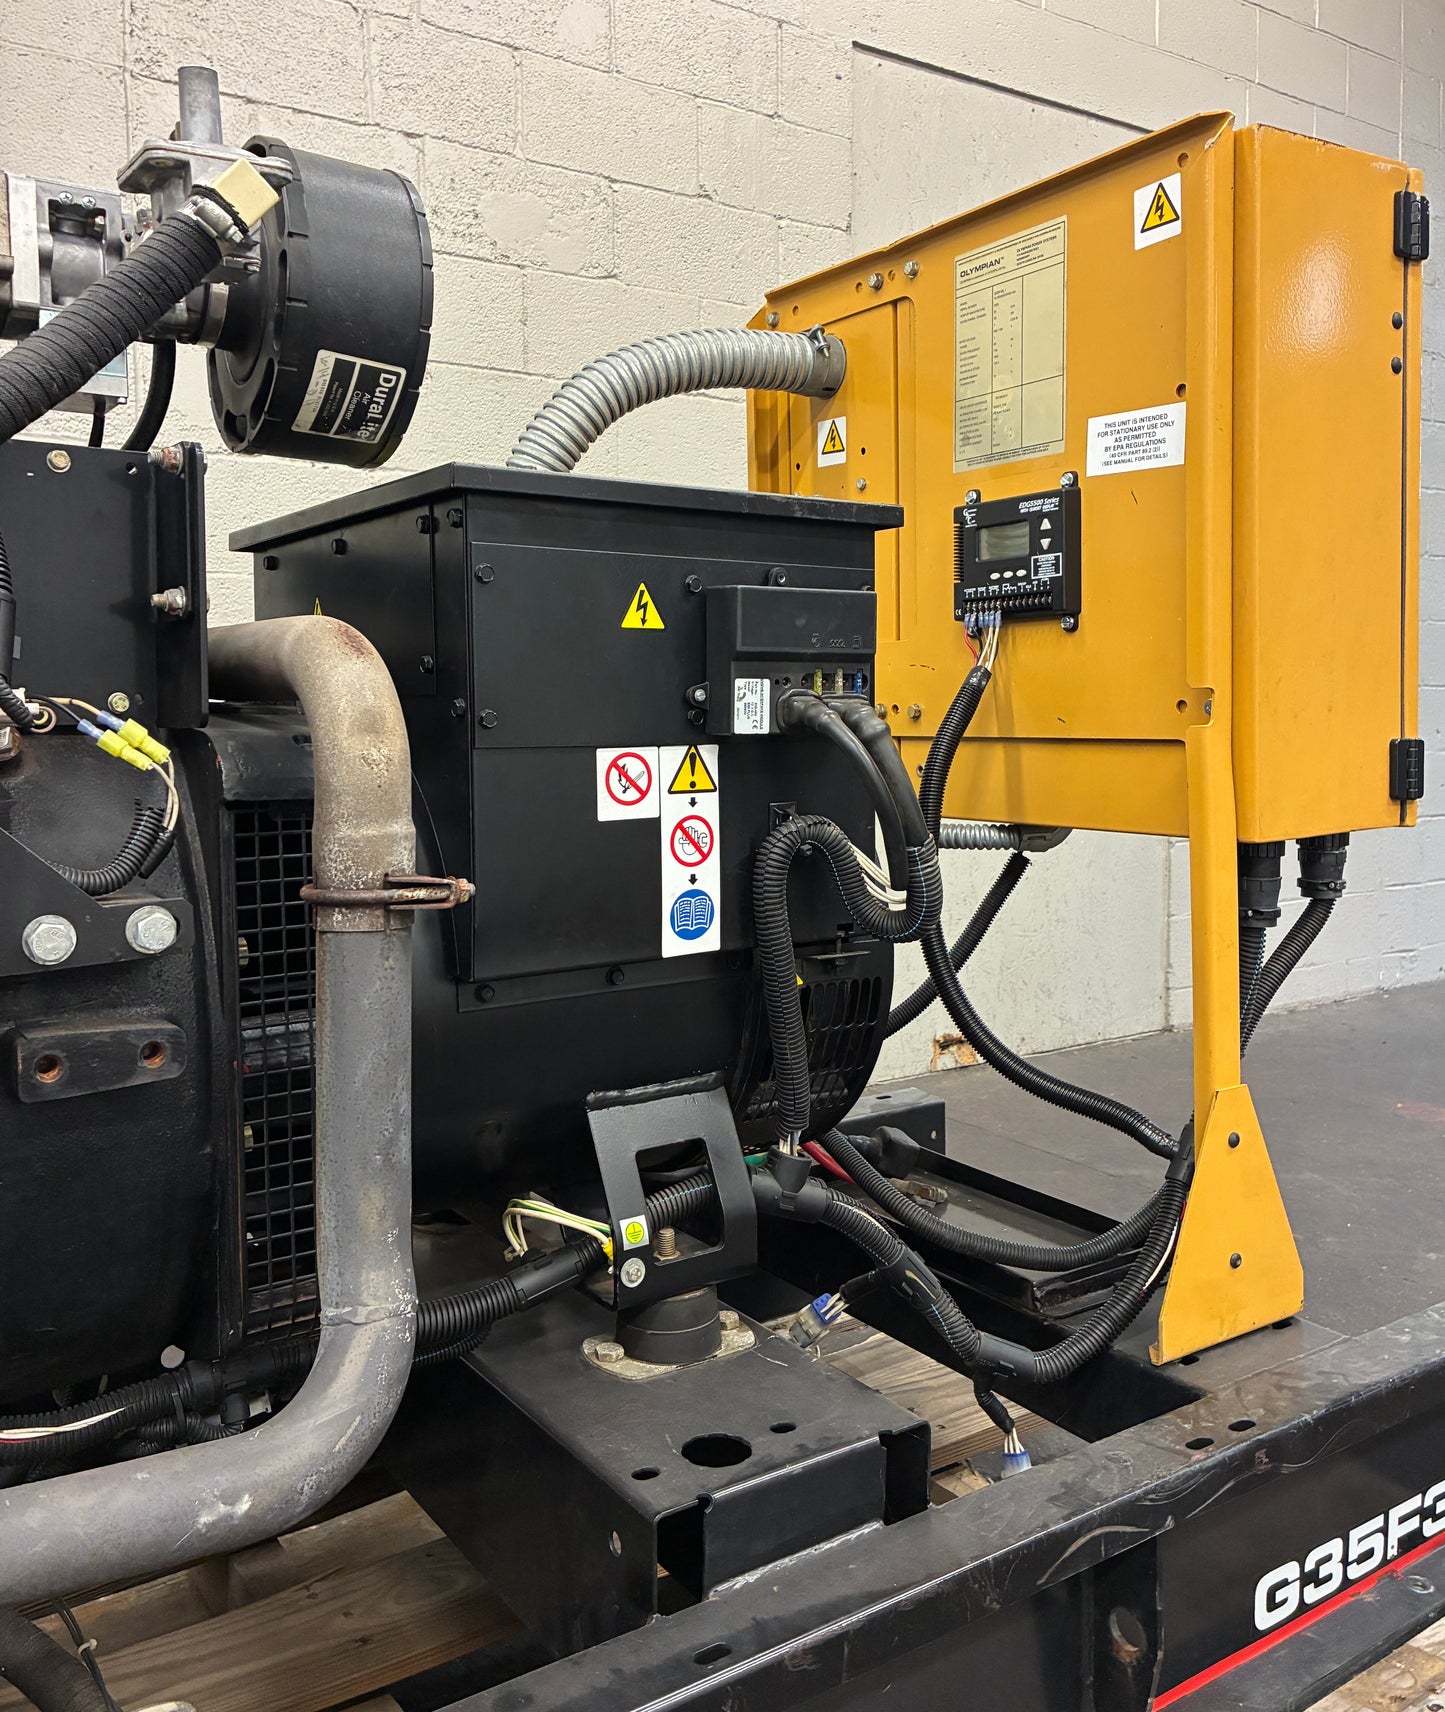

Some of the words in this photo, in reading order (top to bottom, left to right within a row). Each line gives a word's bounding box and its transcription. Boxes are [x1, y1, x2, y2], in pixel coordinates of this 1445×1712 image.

[960, 258, 1001, 278] OLYMPIAN
[345, 390, 362, 420] Cleaner
[356, 373, 397, 440] DuraLite
[361, 392, 372, 405] Air
[1097, 430, 1109, 438] FOR
[1109, 424, 1146, 437] STATIONARY
[1146, 422, 1158, 430] USE
[1159, 420, 1176, 429] ONLY
[1104, 421, 1117, 429] THIS
[1117, 419, 1131, 427] UNIT
[1138, 413, 1168, 424] INTENDED
[1113, 436, 1122, 444] AS
[1123, 431, 1157, 442] PERMITTED
[1125, 437, 1167, 450] REGULATIONS
[1113, 457, 1134, 465] MANUAL
[1146, 452, 1169, 461] DETAILS)
[1044, 497, 1060, 505] Series
[1254, 1479, 1445, 1631] G35F3
